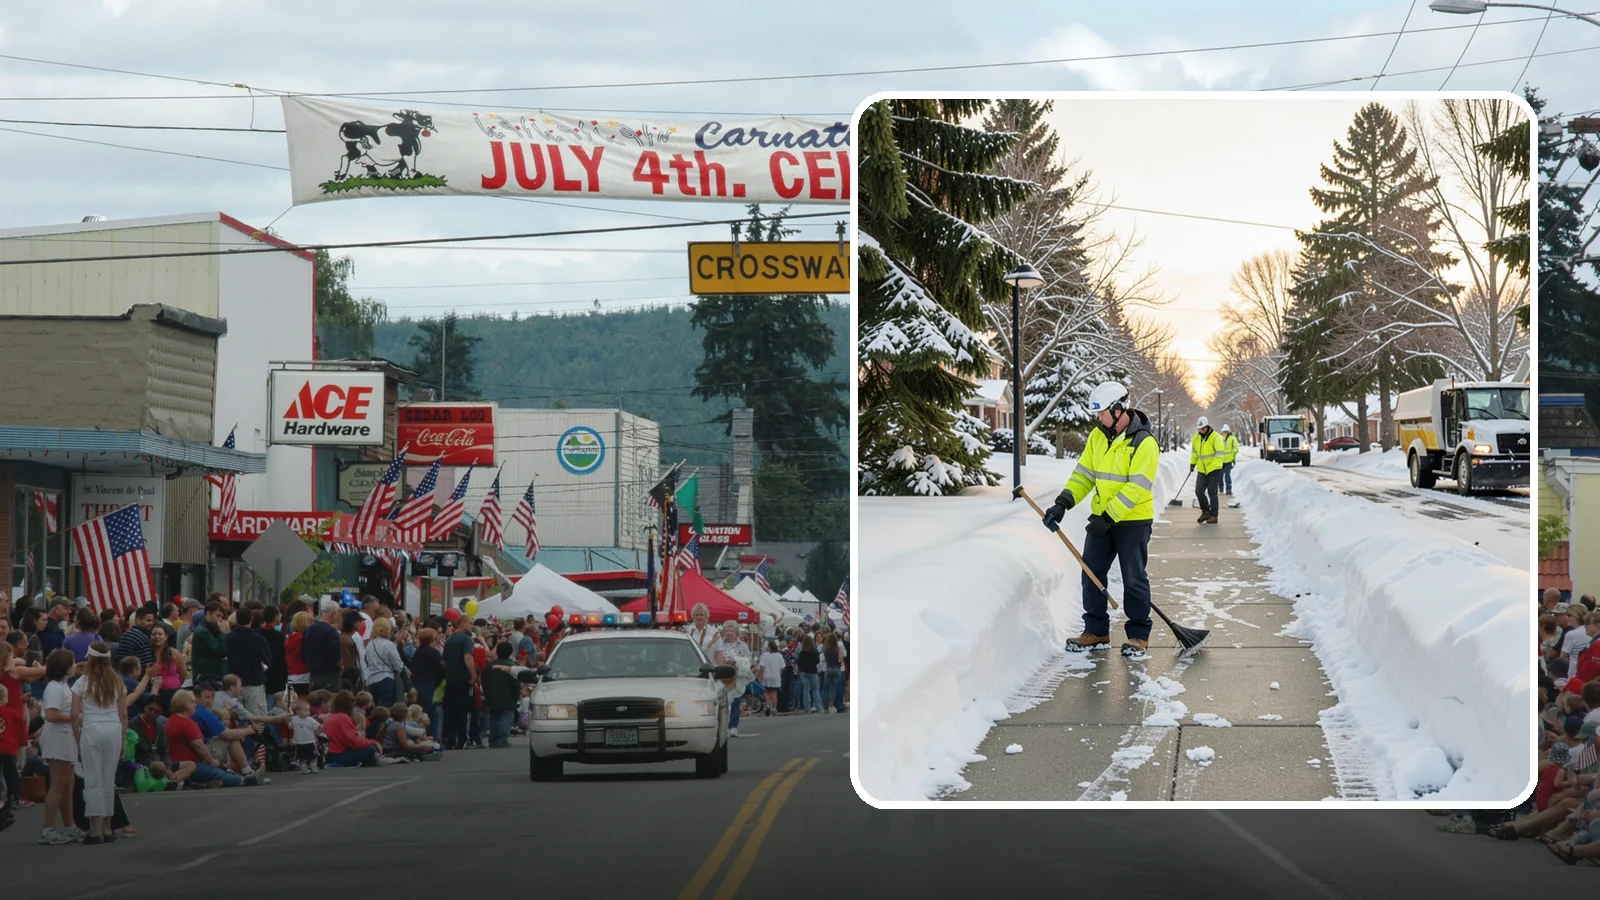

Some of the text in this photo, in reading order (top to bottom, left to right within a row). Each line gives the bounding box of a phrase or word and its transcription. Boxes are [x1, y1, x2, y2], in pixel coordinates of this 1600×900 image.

[695, 121, 850, 149] Carnat
[481, 140, 604, 192] JULY
[632, 150, 746, 197] 4th.
[697, 254, 850, 280] CROSSWA
[283, 380, 373, 420] ACE
[405, 409, 453, 422] CEDAR
[283, 421, 370, 436] Hardware
[353, 467, 385, 480] Simpl
[95, 485, 124, 495] Vincent
[126, 485, 136, 495] de
[138, 486, 155, 495] Paul
[688, 526, 741, 535] CRNATION
[699, 535, 730, 543] GLASS
